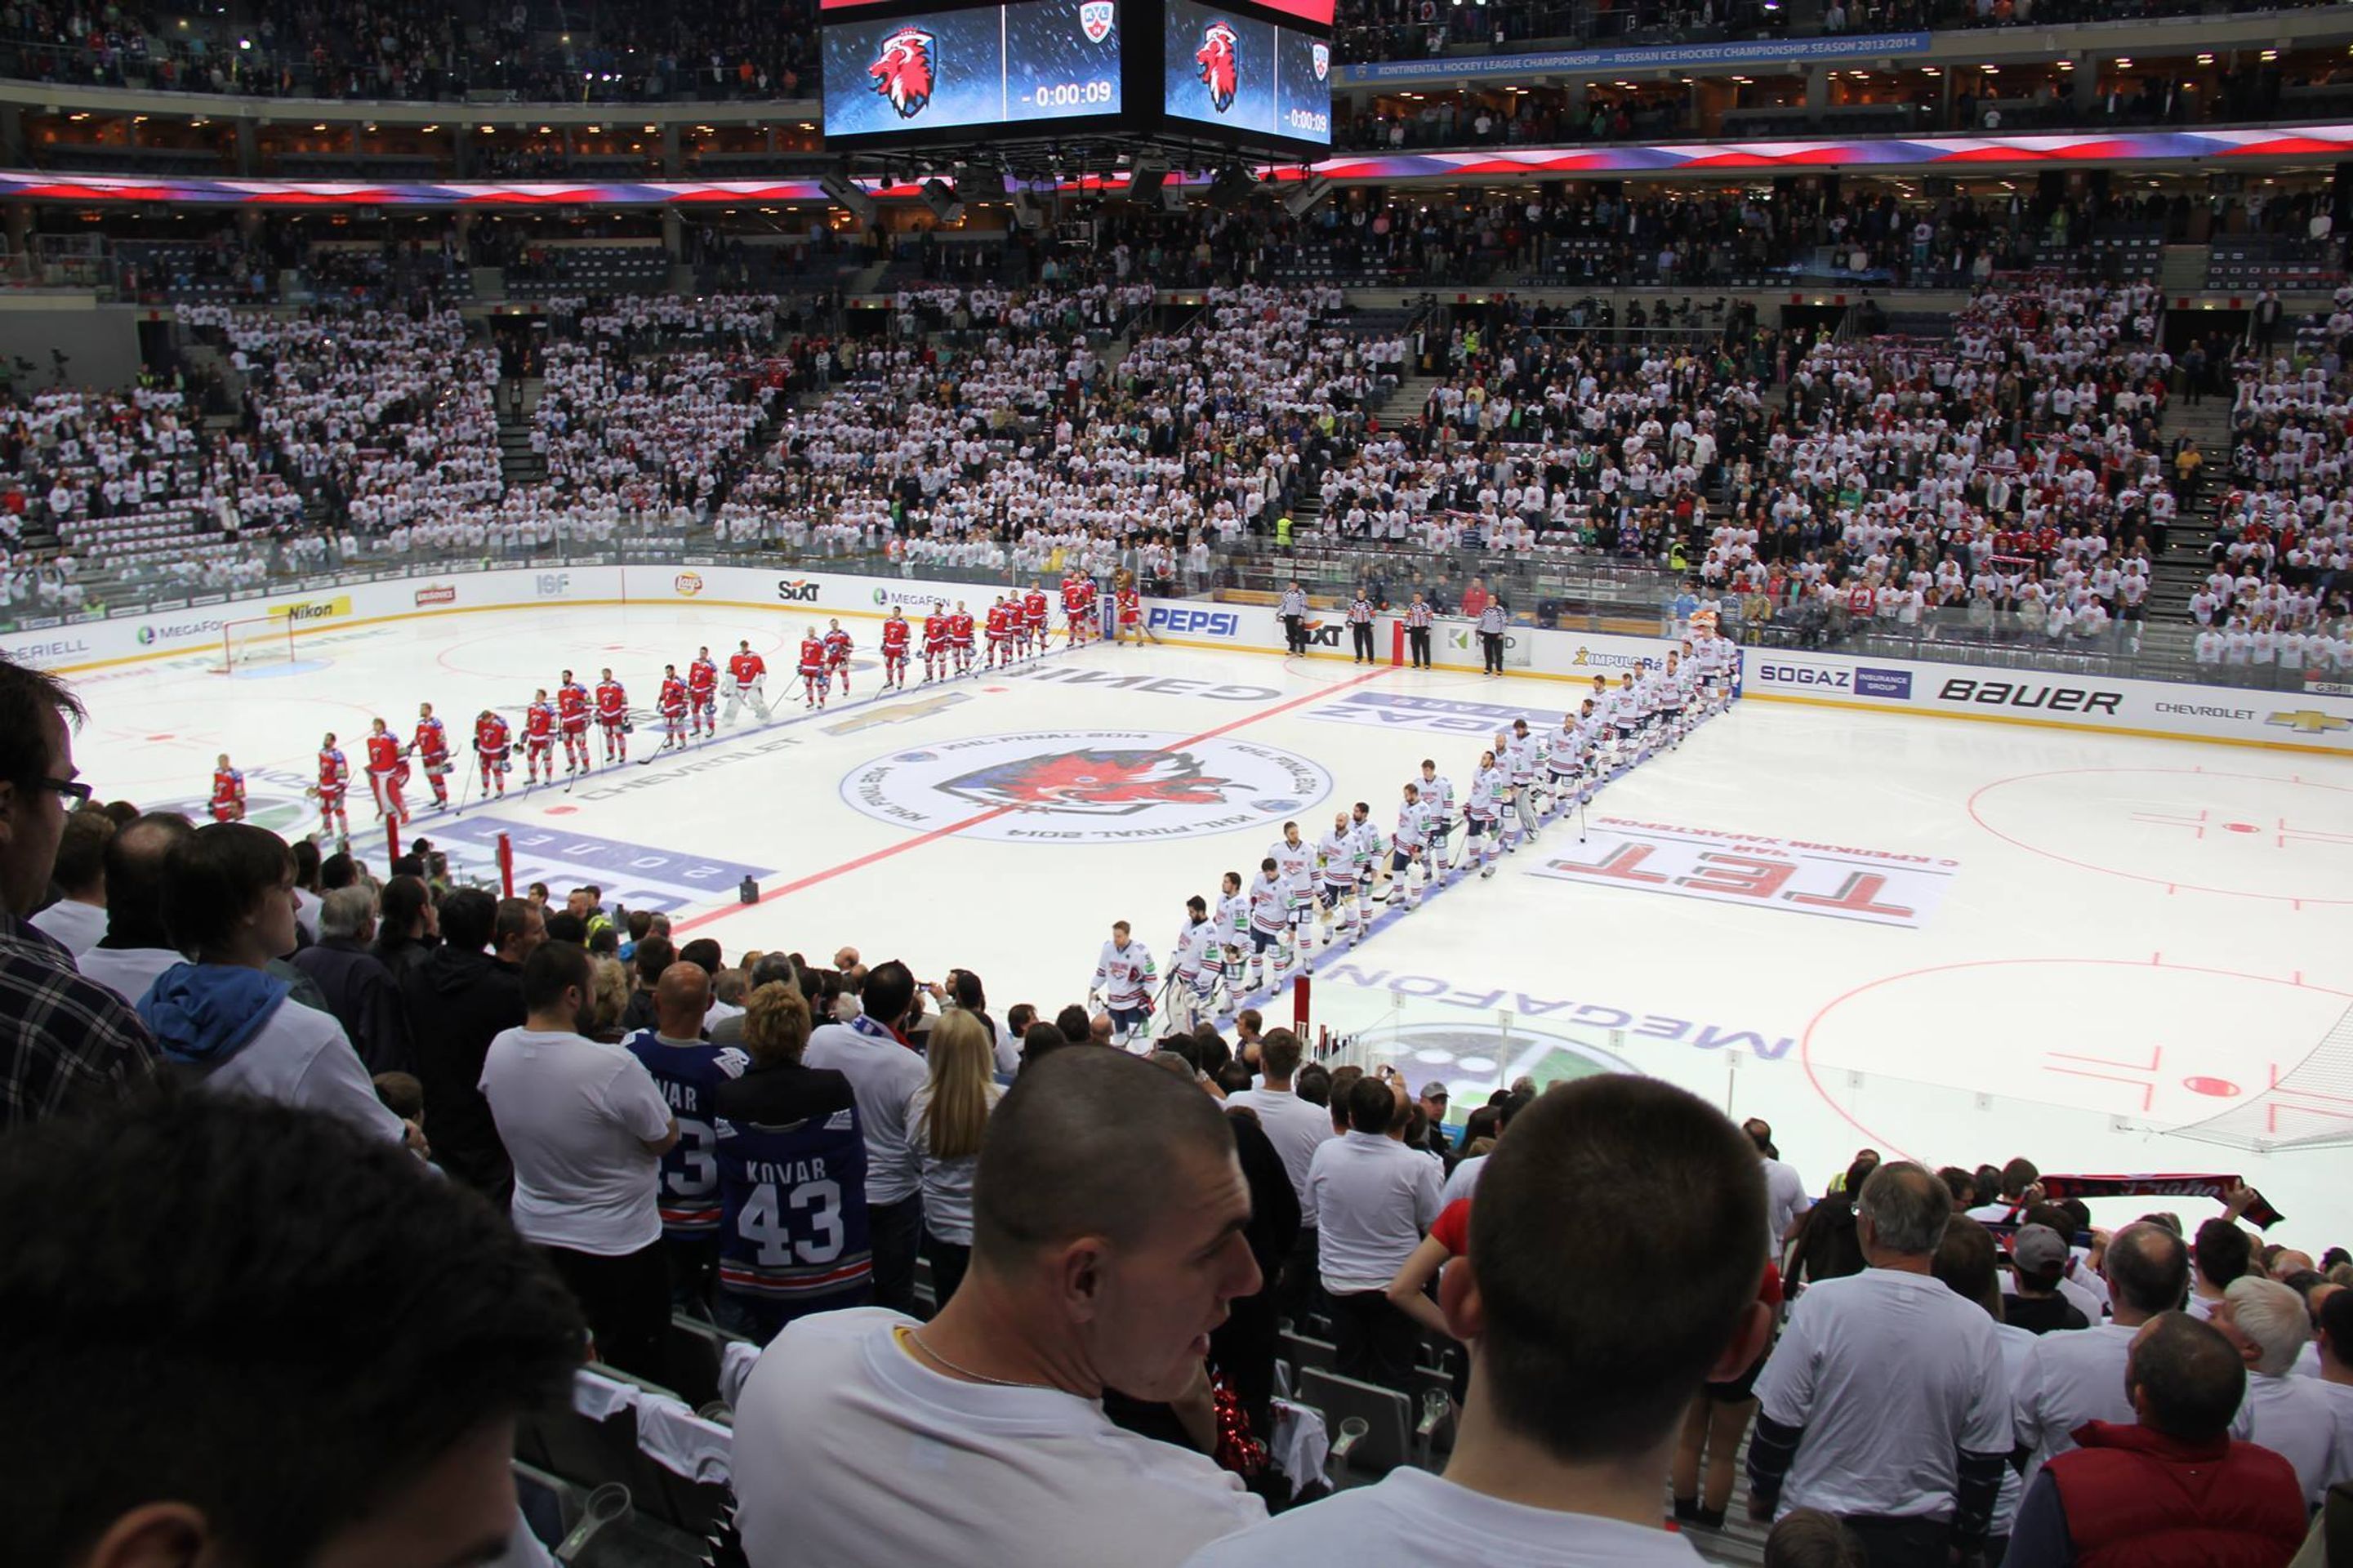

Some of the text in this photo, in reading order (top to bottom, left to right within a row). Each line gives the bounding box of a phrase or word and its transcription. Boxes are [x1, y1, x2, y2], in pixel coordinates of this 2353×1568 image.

[1379, 64, 1442, 75] KONTINENTAL
[1444, 61, 1482, 73] HOCKEY
[1483, 59, 1522, 70] LEAGUE
[1523, 54, 1600, 68] CHAMPIONSHIP
[1615, 51, 1659, 63] RUSSIAN
[1660, 50, 1677, 60] ICE
[1679, 48, 1721, 59] HOCKEY
[1812, 41, 1856, 53] SEASON
[1858, 38, 1917, 51] 2013/2014
[289, 603, 332, 620] Nikon
[1148, 608, 1239, 637] PEPSI
[1760, 666, 1908, 688] SOGAZ INSURANCE
[1867, 683, 1897, 692] GROUP
[1938, 679, 2123, 715] BAUER
[2155, 702, 2256, 720] CHEVROLET
[576, 737, 803, 800] CHEVROLET
[1093, 825, 1192, 839] FINAL
[1193, 813, 1256, 828] KHL
[1322, 964, 1794, 1061] MEGAFON
[656, 1079, 697, 1111] VAR
[656, 1116, 717, 1196] 3
[746, 1156, 827, 1185] KOVAR
[738, 1178, 844, 1266] 43
